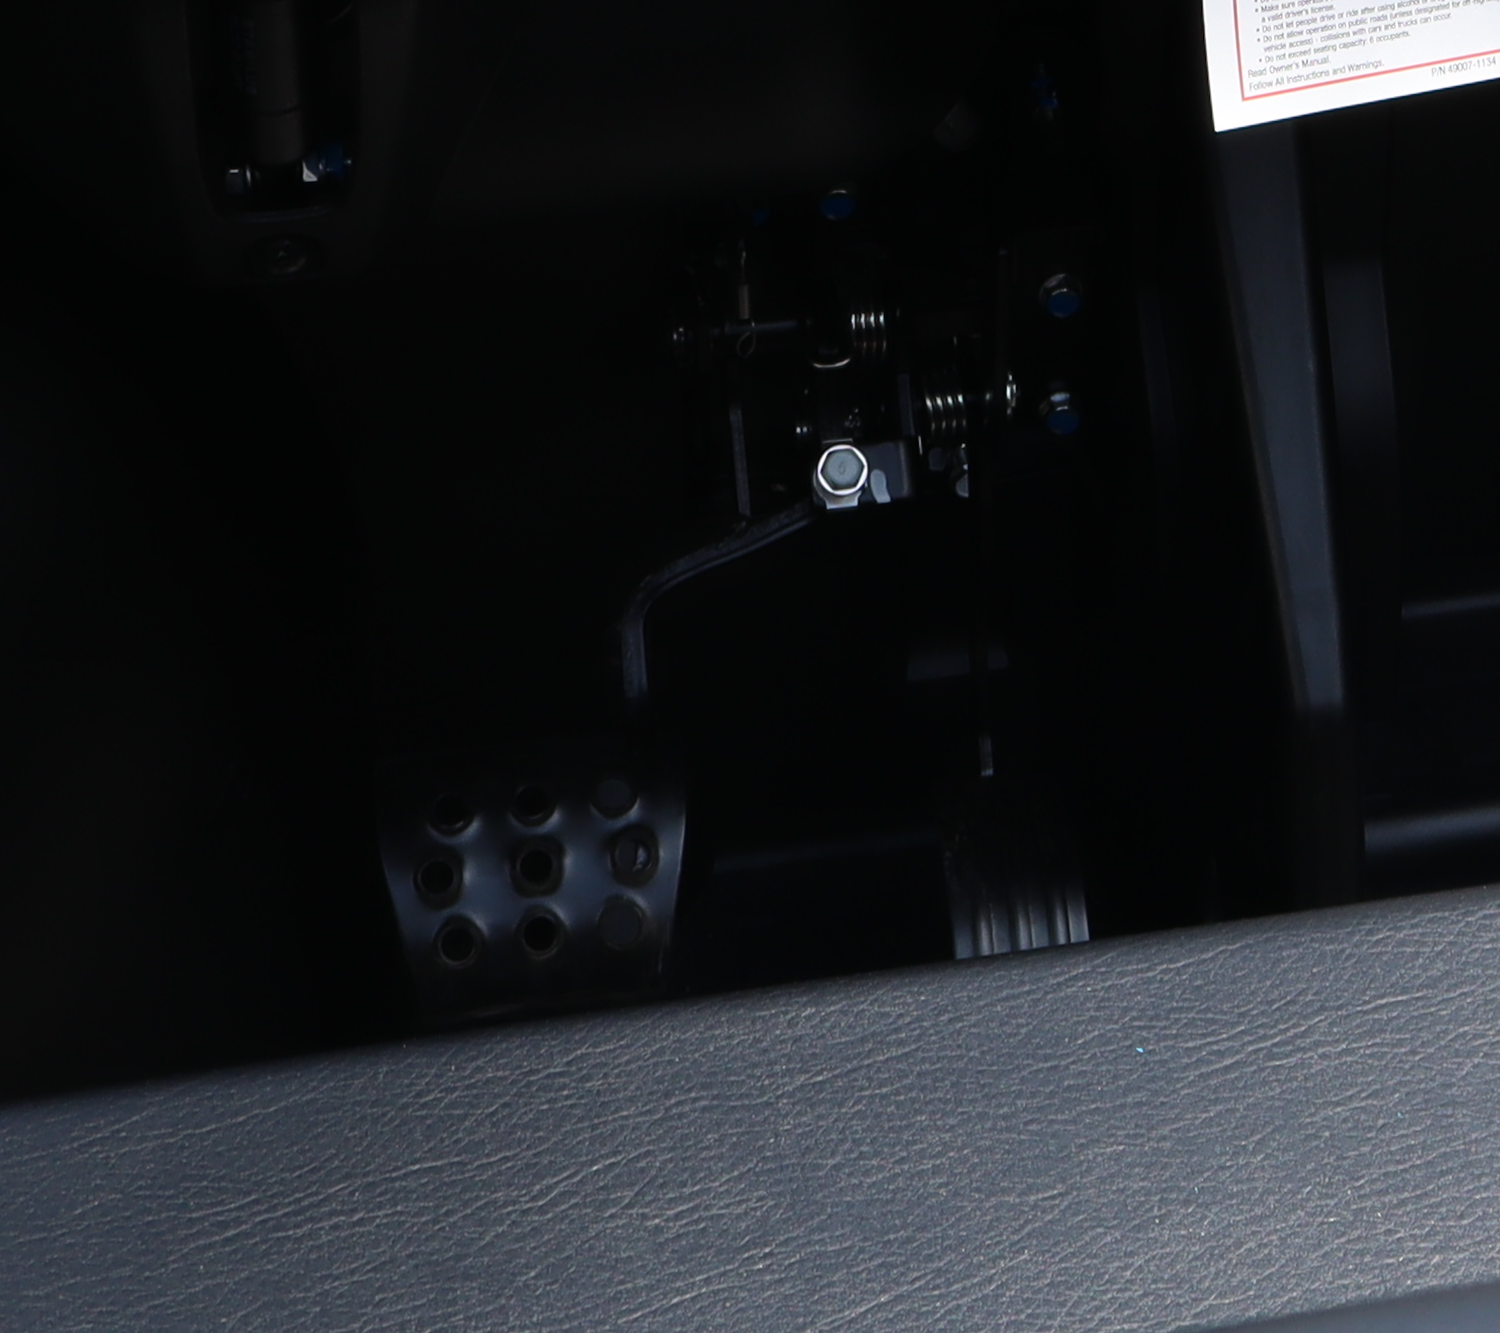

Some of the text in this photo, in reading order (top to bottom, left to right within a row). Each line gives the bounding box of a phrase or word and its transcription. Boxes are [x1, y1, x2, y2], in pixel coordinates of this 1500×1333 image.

[1248, 55, 1330, 77] Read Owner's Manual.
[1249, 58, 1384, 90] Follow All Instructions and Warnings.
